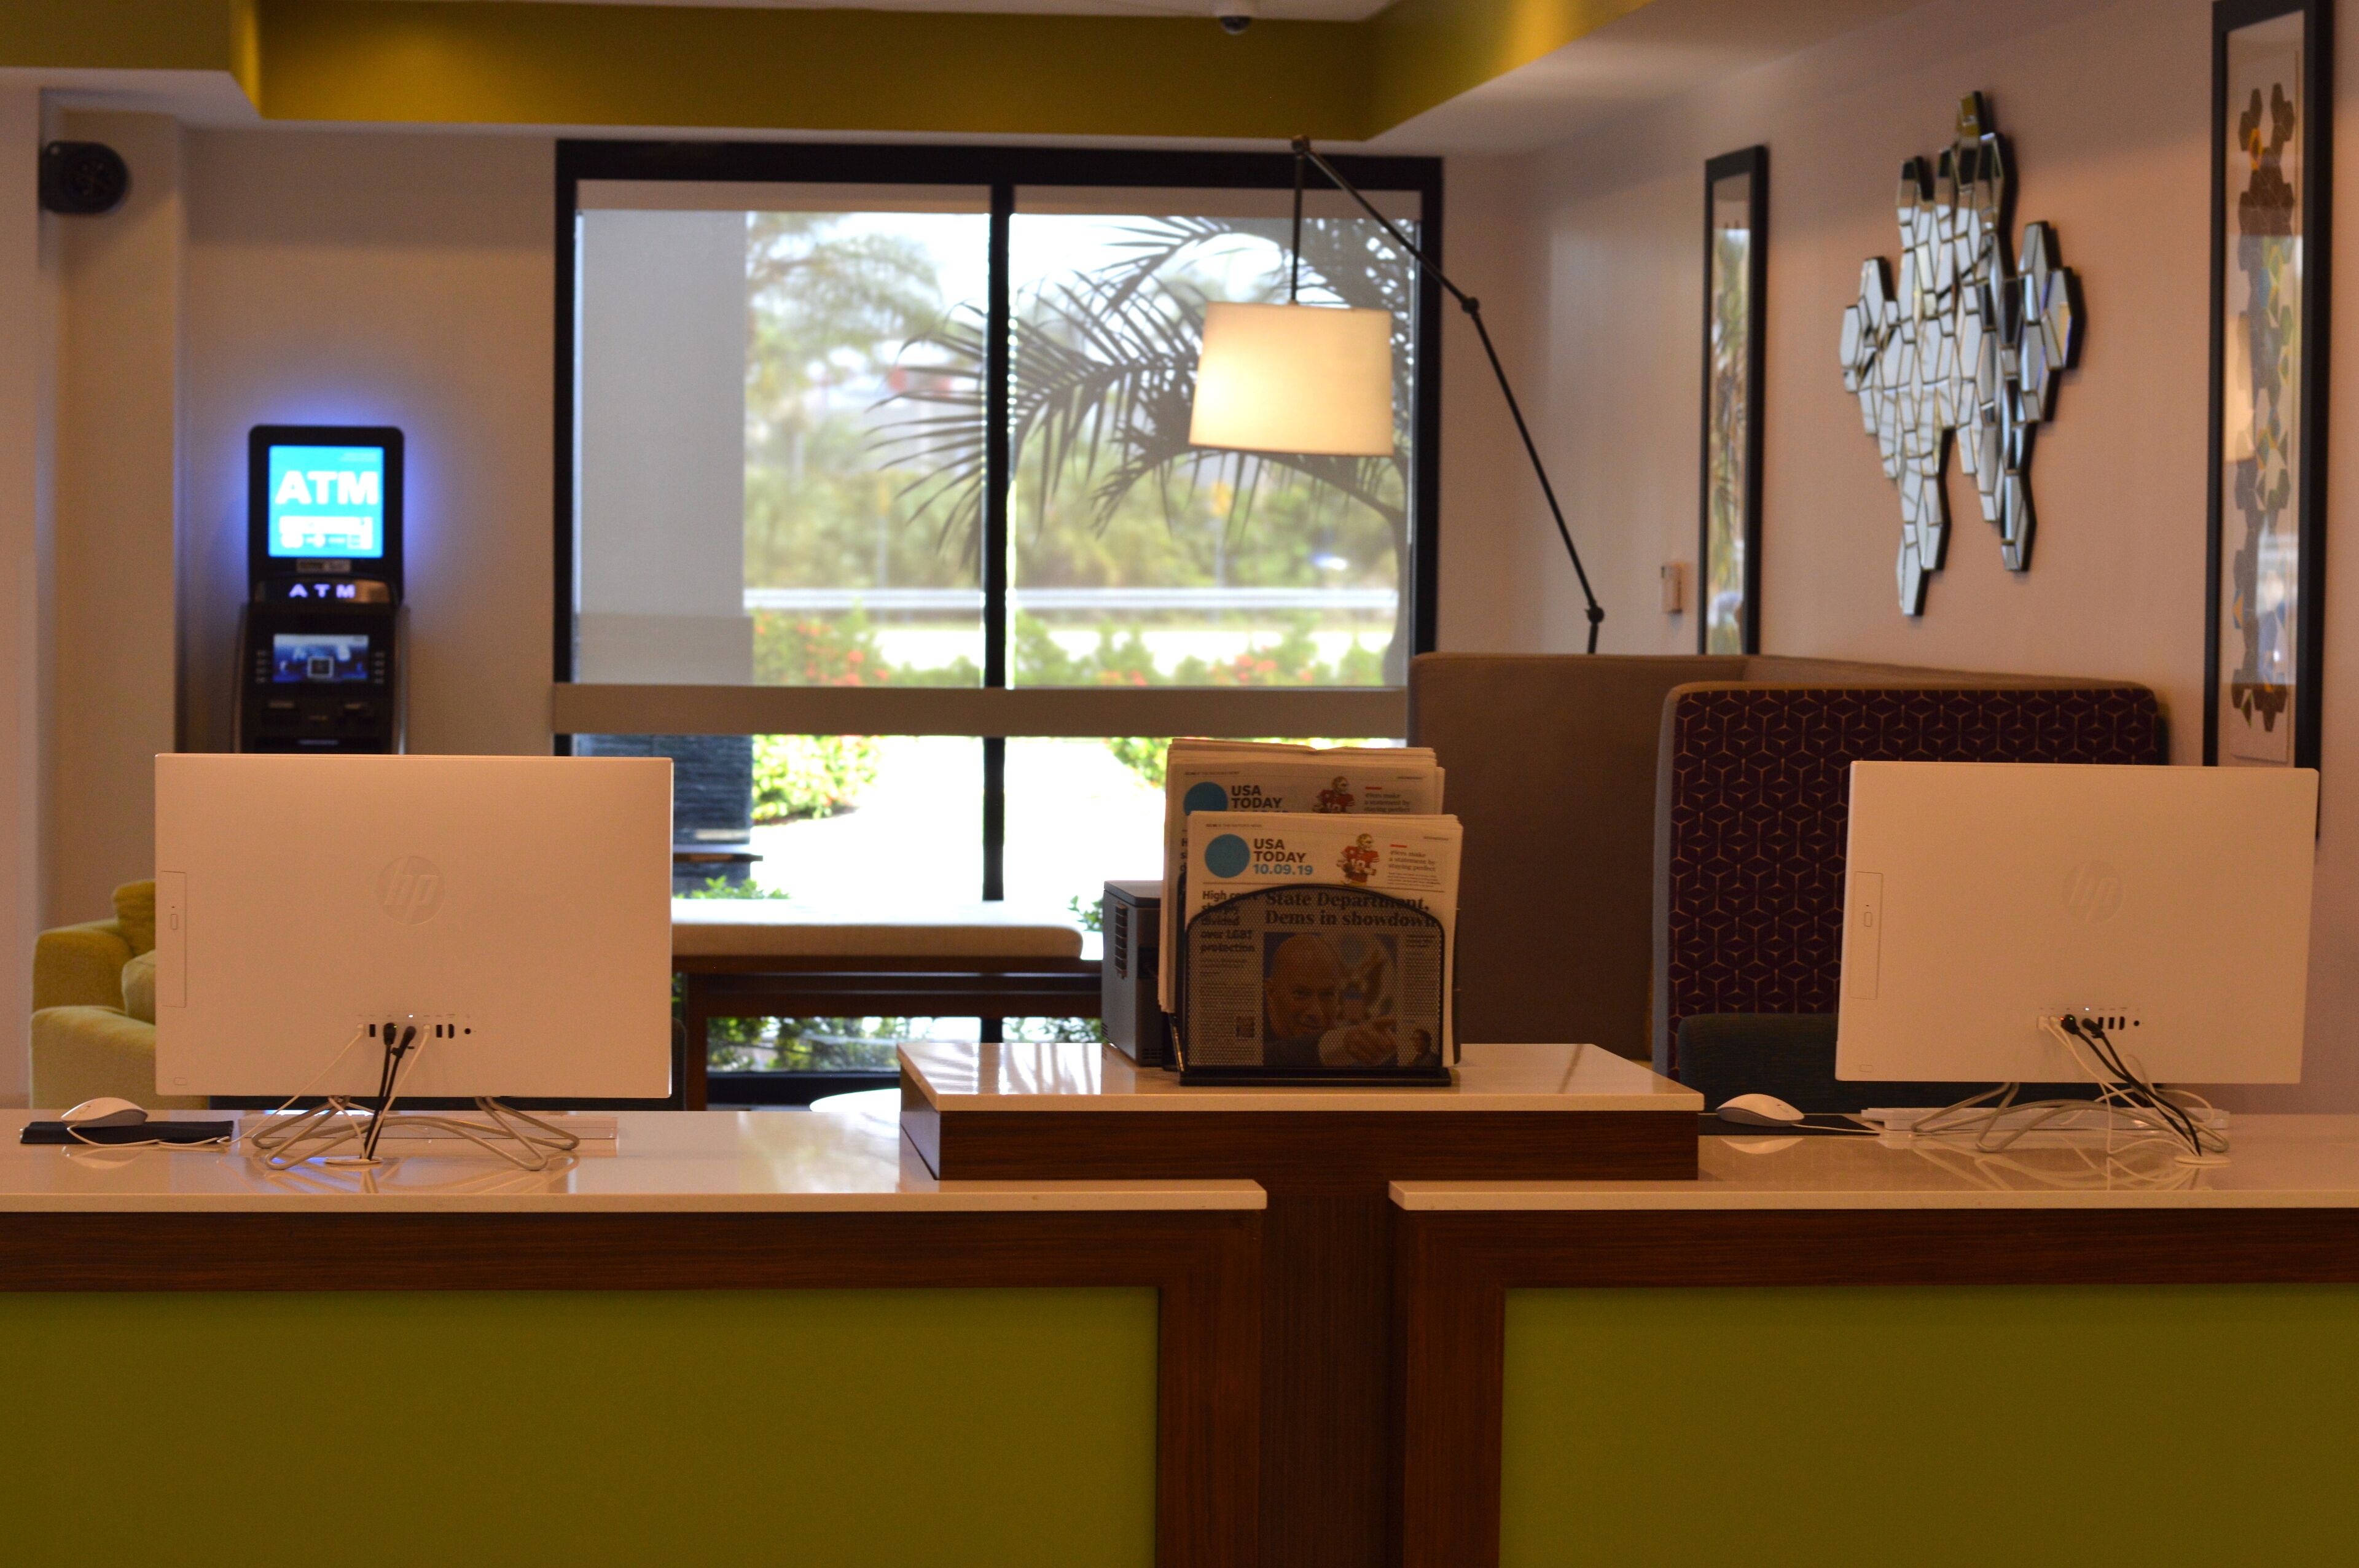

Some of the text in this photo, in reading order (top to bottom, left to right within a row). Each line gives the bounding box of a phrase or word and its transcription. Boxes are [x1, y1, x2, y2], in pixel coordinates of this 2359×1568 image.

[275, 470, 379, 504] ATM
[289, 583, 356, 598] ATM
[1231, 785, 1261, 796] USA
[1230, 797, 1283, 809] TODAY
[1254, 838, 1285, 849] USA
[1253, 851, 1307, 863] TODAY
[1253, 864, 1313, 875] 10.09.19
[382, 856, 440, 926] hp
[1202, 890, 1227, 902] High
[1266, 892, 1312, 906] State
[1266, 910, 1438, 927] Dems in showdown
